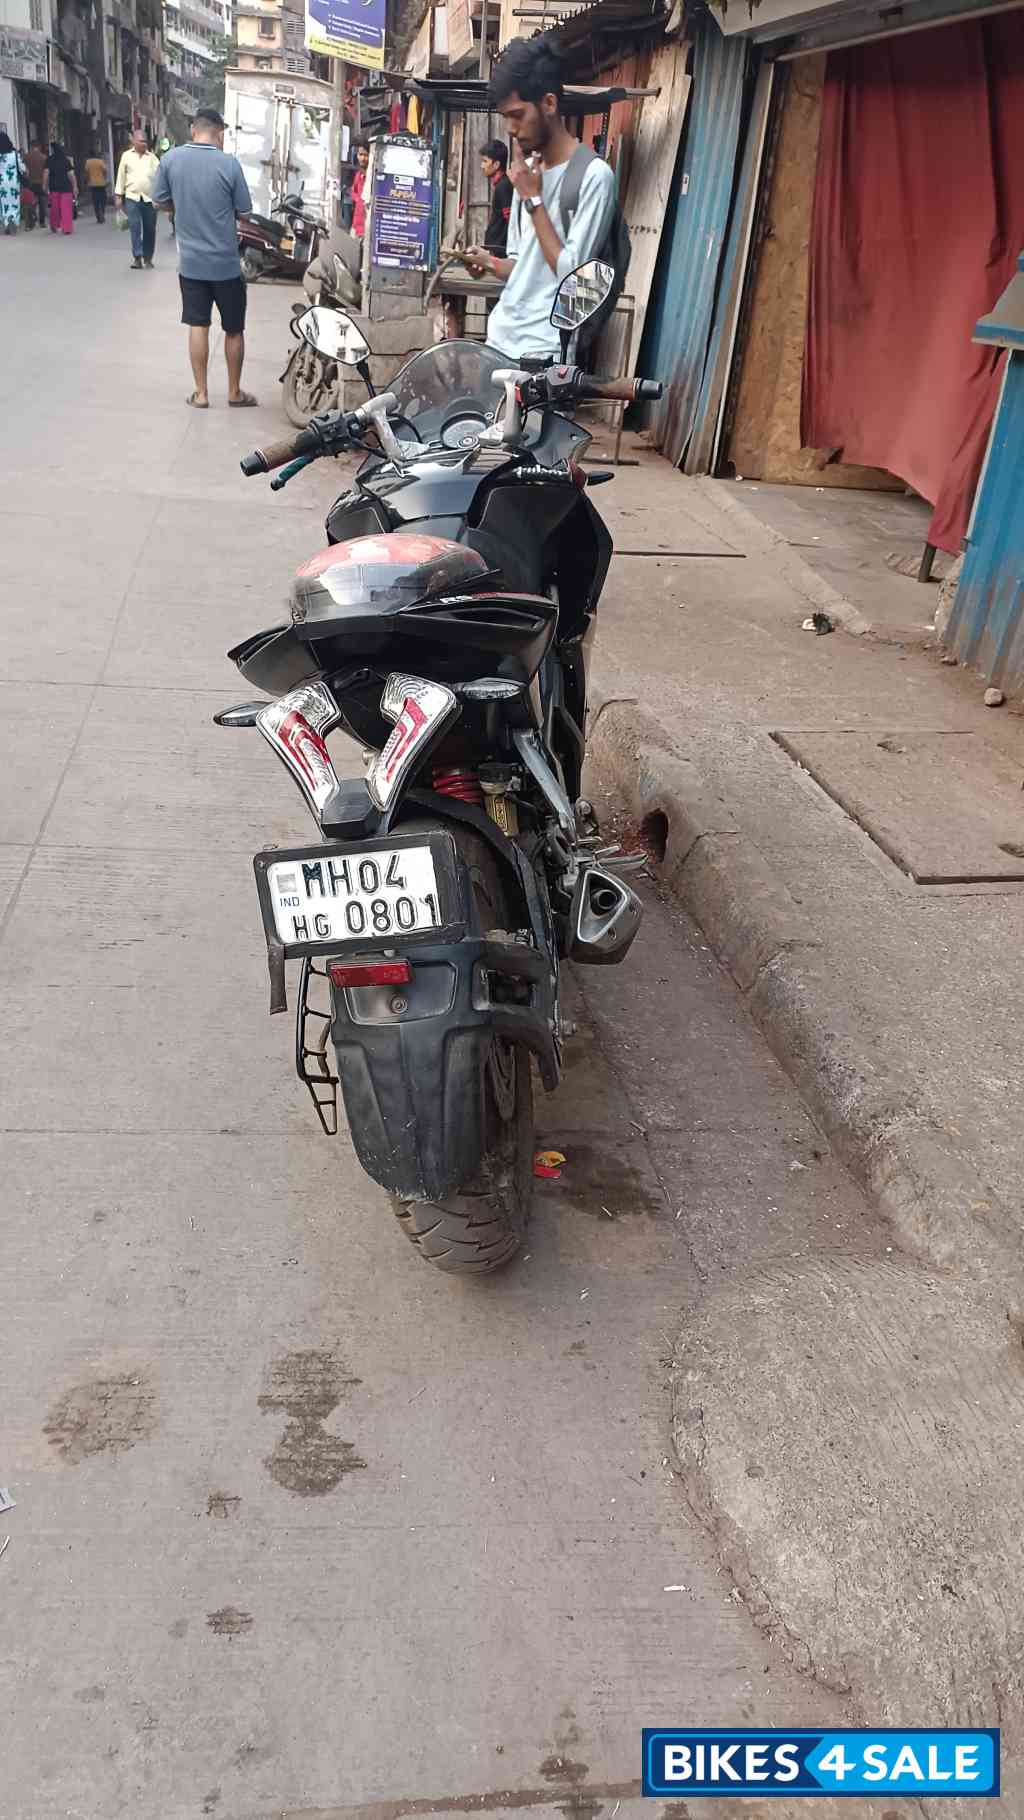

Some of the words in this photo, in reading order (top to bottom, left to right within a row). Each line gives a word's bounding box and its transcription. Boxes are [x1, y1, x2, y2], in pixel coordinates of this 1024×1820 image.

[301, 853, 407, 898] MH04
[279, 896, 300, 908] IND
[292, 913, 332, 940] HG
[346, 893, 442, 935] 0801
